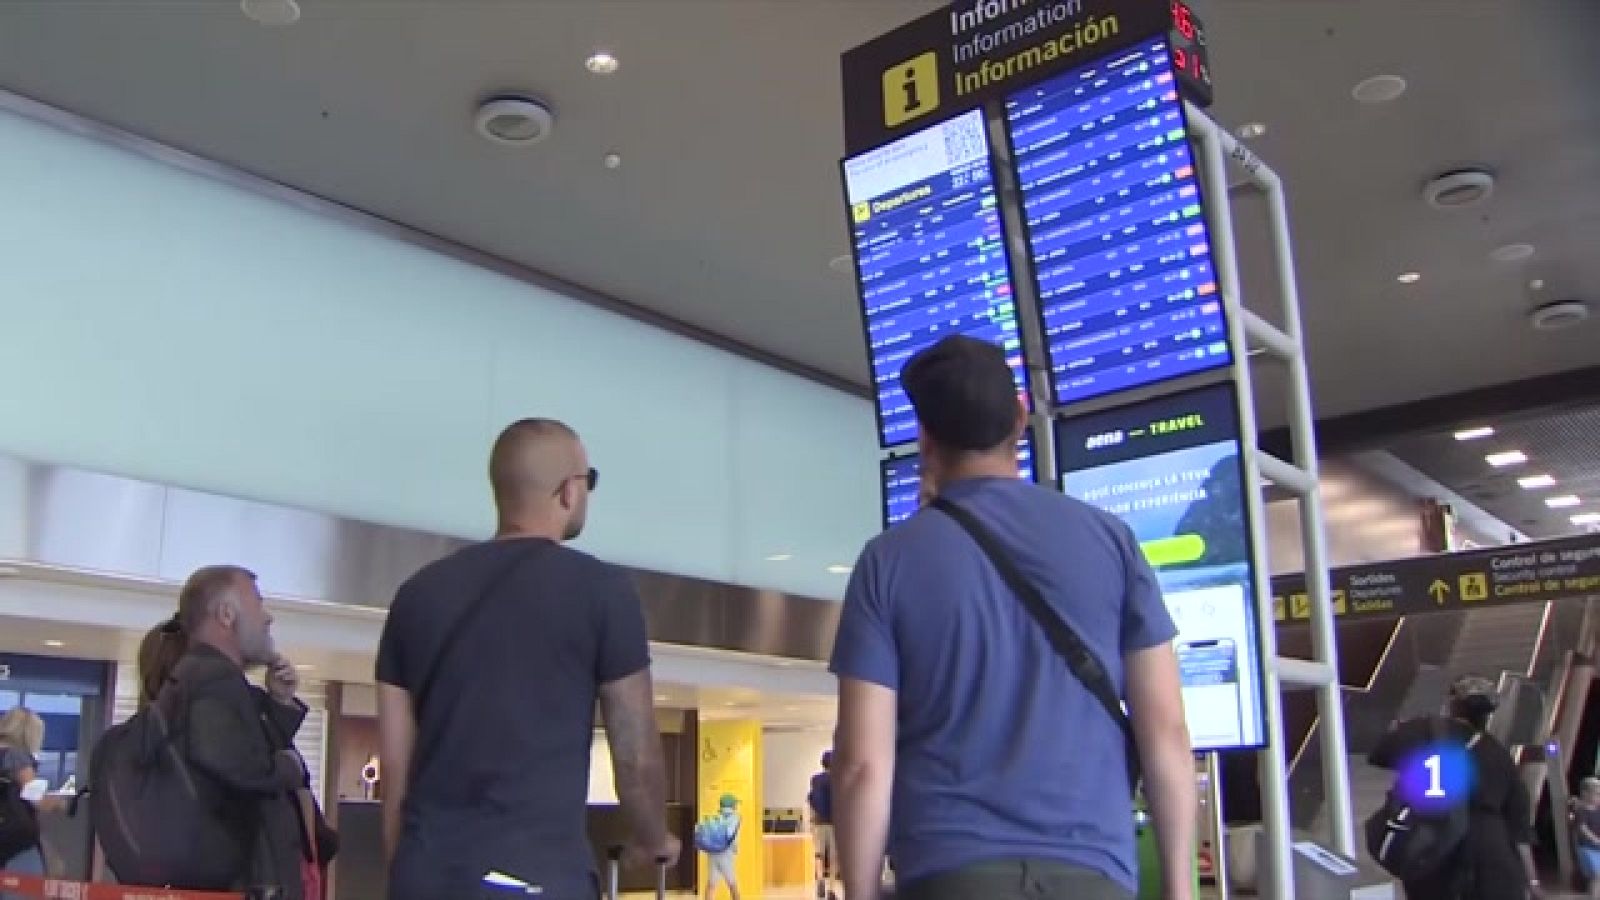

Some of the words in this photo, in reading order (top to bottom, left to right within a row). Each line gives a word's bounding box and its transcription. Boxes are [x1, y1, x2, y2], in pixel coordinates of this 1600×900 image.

[953, 0, 1082, 64] Information
[955, 15, 1119, 96] Información
[1150, 414, 1204, 436] TRAVEL
[1164, 474, 1178, 486] LA
[1491, 551, 1536, 568] Control
[1494, 581, 1541, 596] Control
